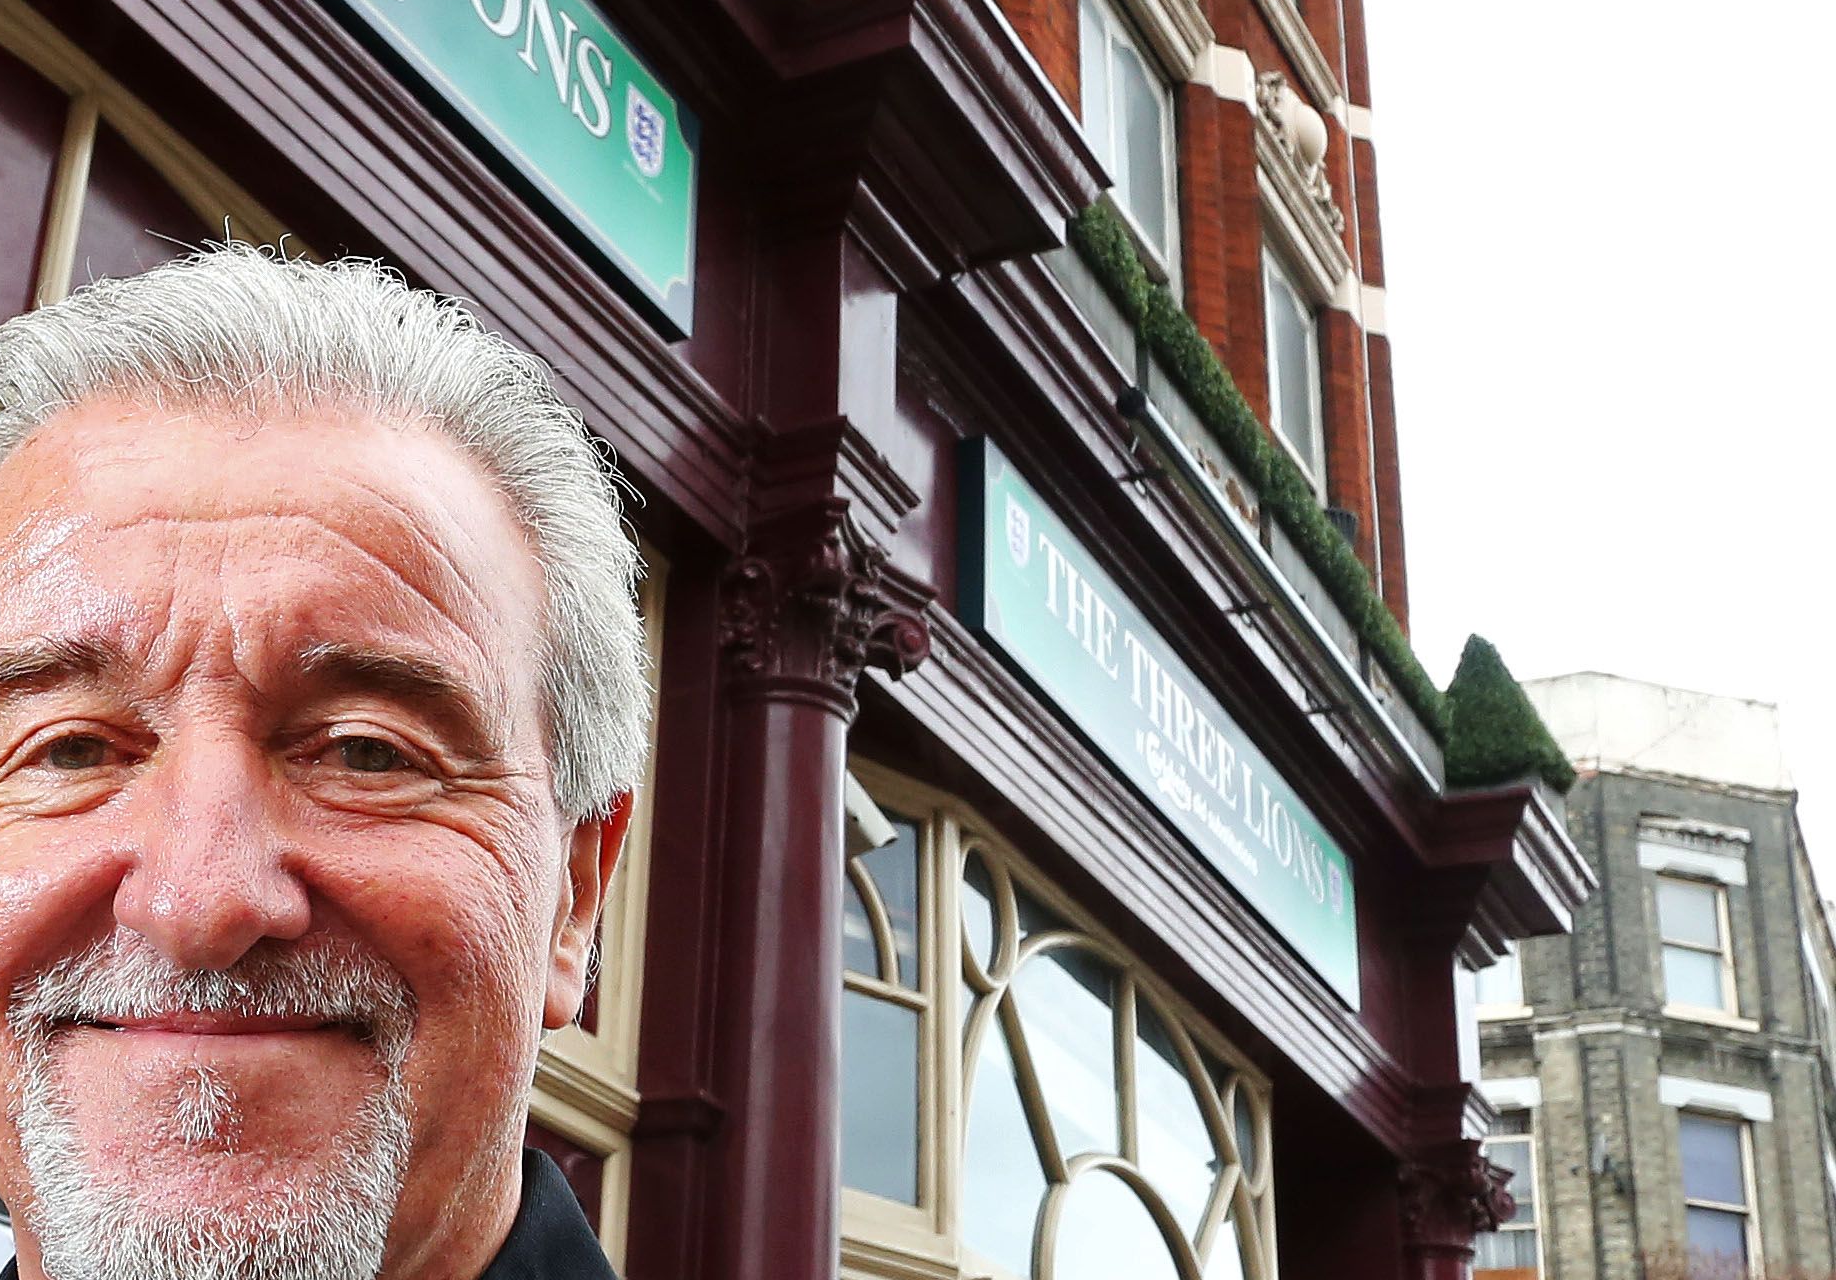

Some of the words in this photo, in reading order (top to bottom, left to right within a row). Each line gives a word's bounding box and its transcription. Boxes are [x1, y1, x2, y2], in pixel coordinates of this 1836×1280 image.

[1039, 532, 1118, 681] THE
[1124, 630, 1237, 810] THREE
[1241, 760, 1325, 904] LIONS
